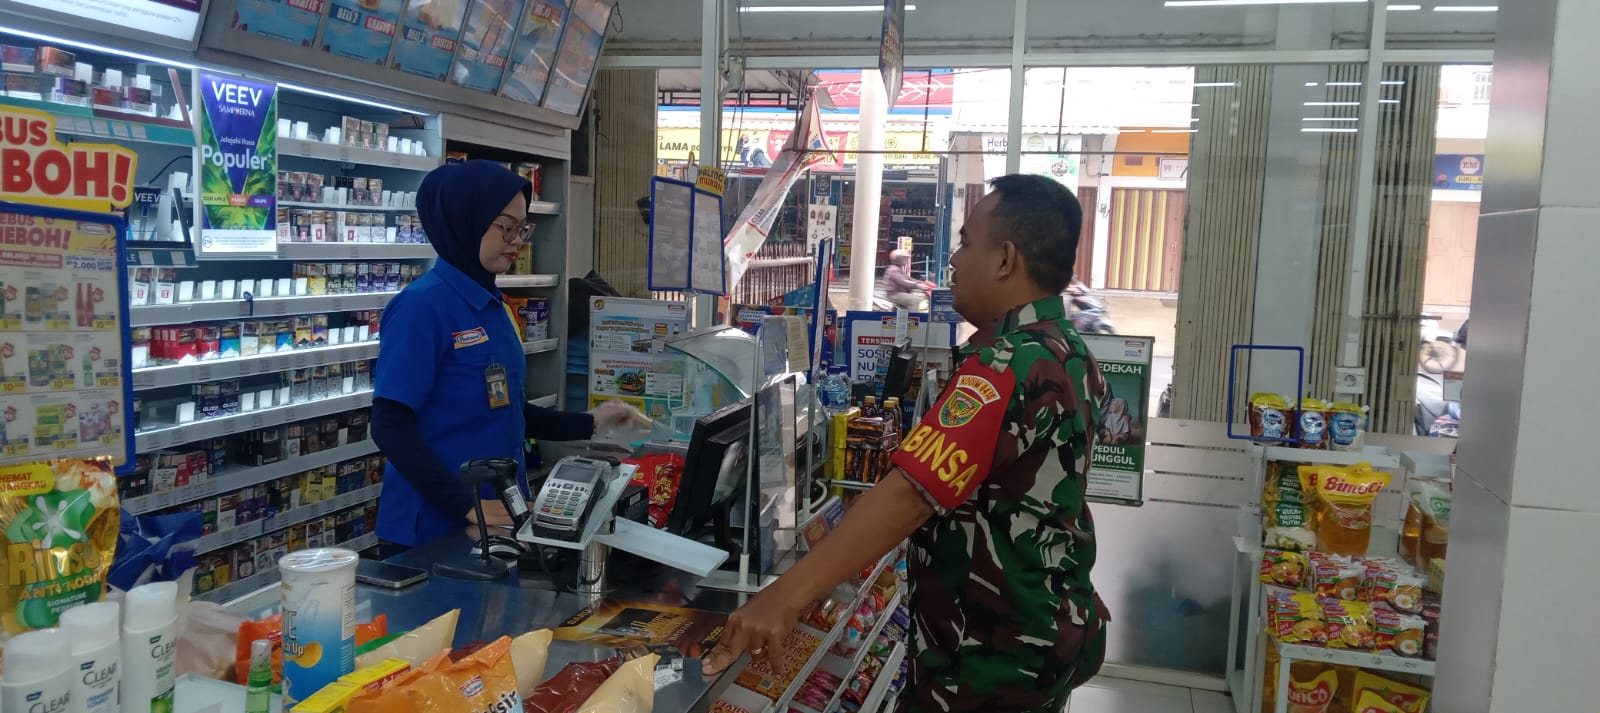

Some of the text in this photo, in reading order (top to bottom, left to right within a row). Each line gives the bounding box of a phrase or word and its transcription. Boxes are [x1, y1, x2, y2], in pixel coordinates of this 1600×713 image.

[212, 81, 262, 107] VEEV
[660, 142, 689, 151] LAMA
[1, 149, 131, 203] BOH!
[698, 168, 724, 181] PALING
[134, 192, 160, 203] VEEV
[1092, 445, 1125, 455] PEDULI
[900, 424, 978, 497] BINSA
[1091, 454, 1136, 466] UNGGUL
[1324, 475, 1384, 495] Bimoli
[8, 538, 100, 585] Rinso
[20, 584, 62, 601] ANTI
[83, 662, 118, 687] CLEAR
